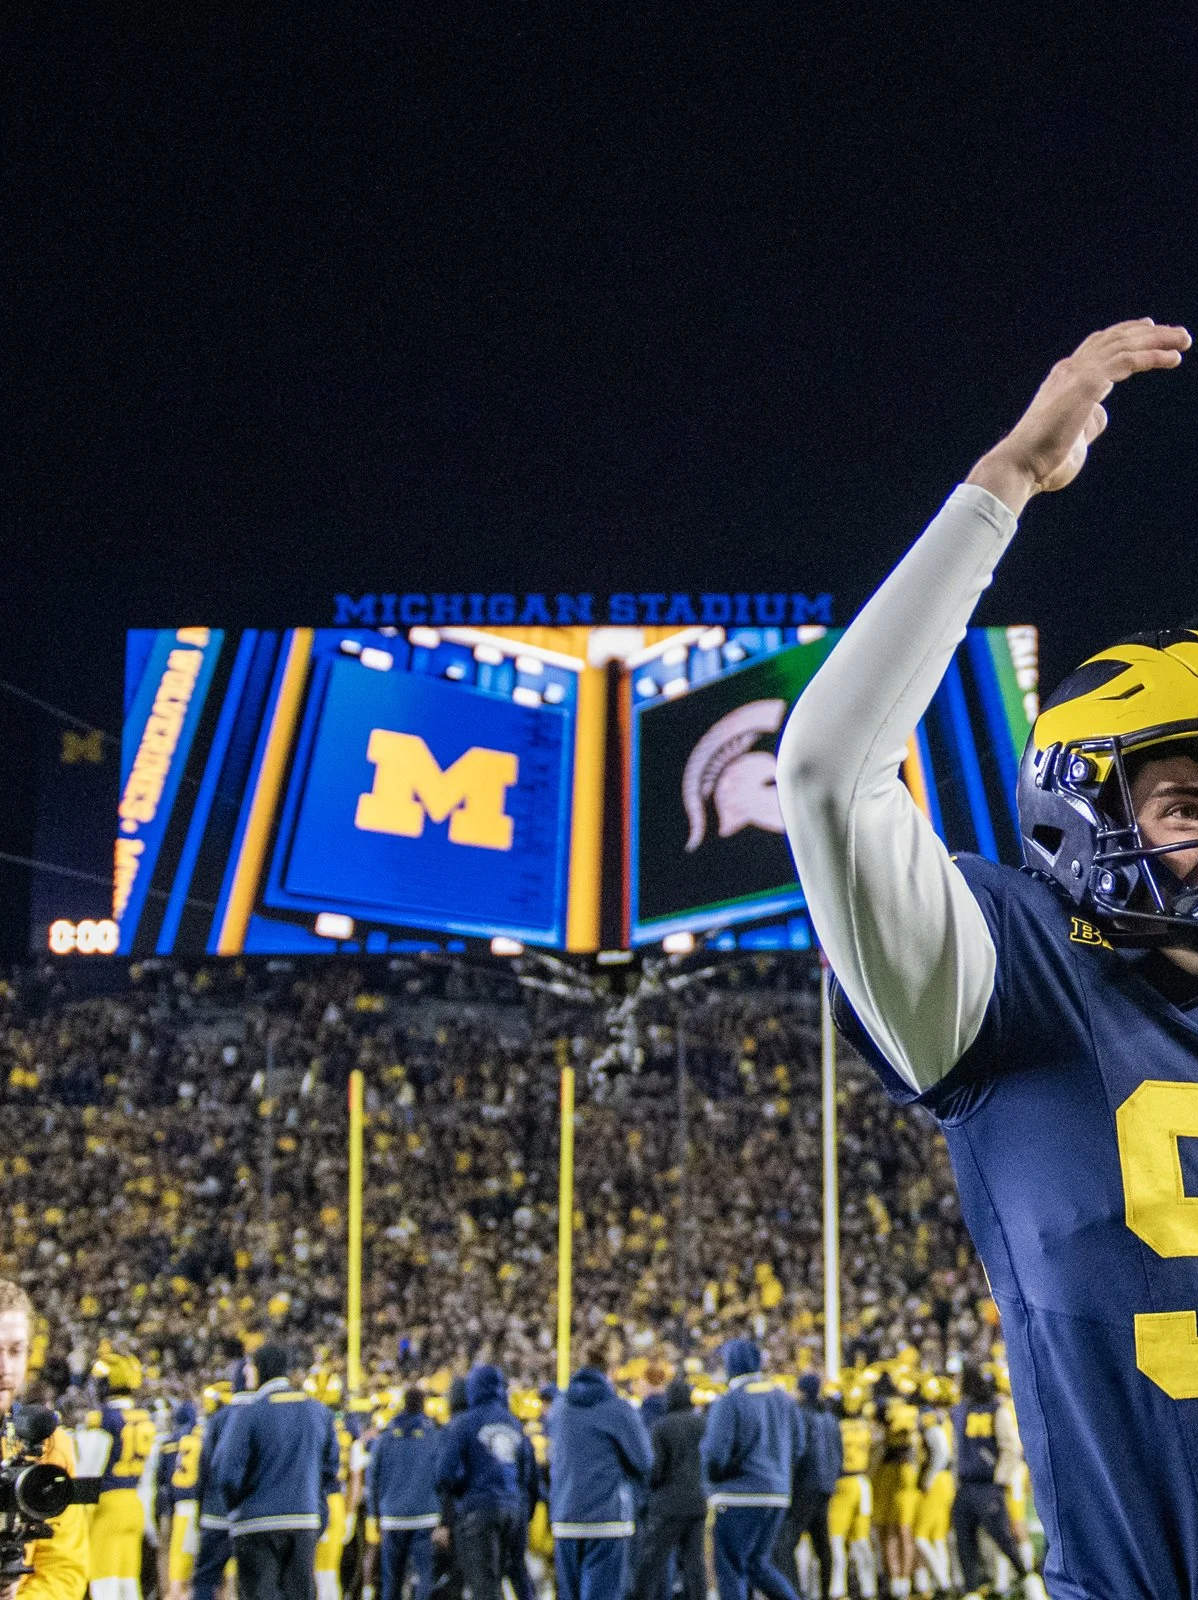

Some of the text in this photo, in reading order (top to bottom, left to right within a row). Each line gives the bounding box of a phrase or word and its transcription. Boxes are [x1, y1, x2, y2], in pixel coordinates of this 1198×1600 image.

[334, 593, 833, 624] MICHIGAN STADIUM
[355, 728, 519, 852] M
